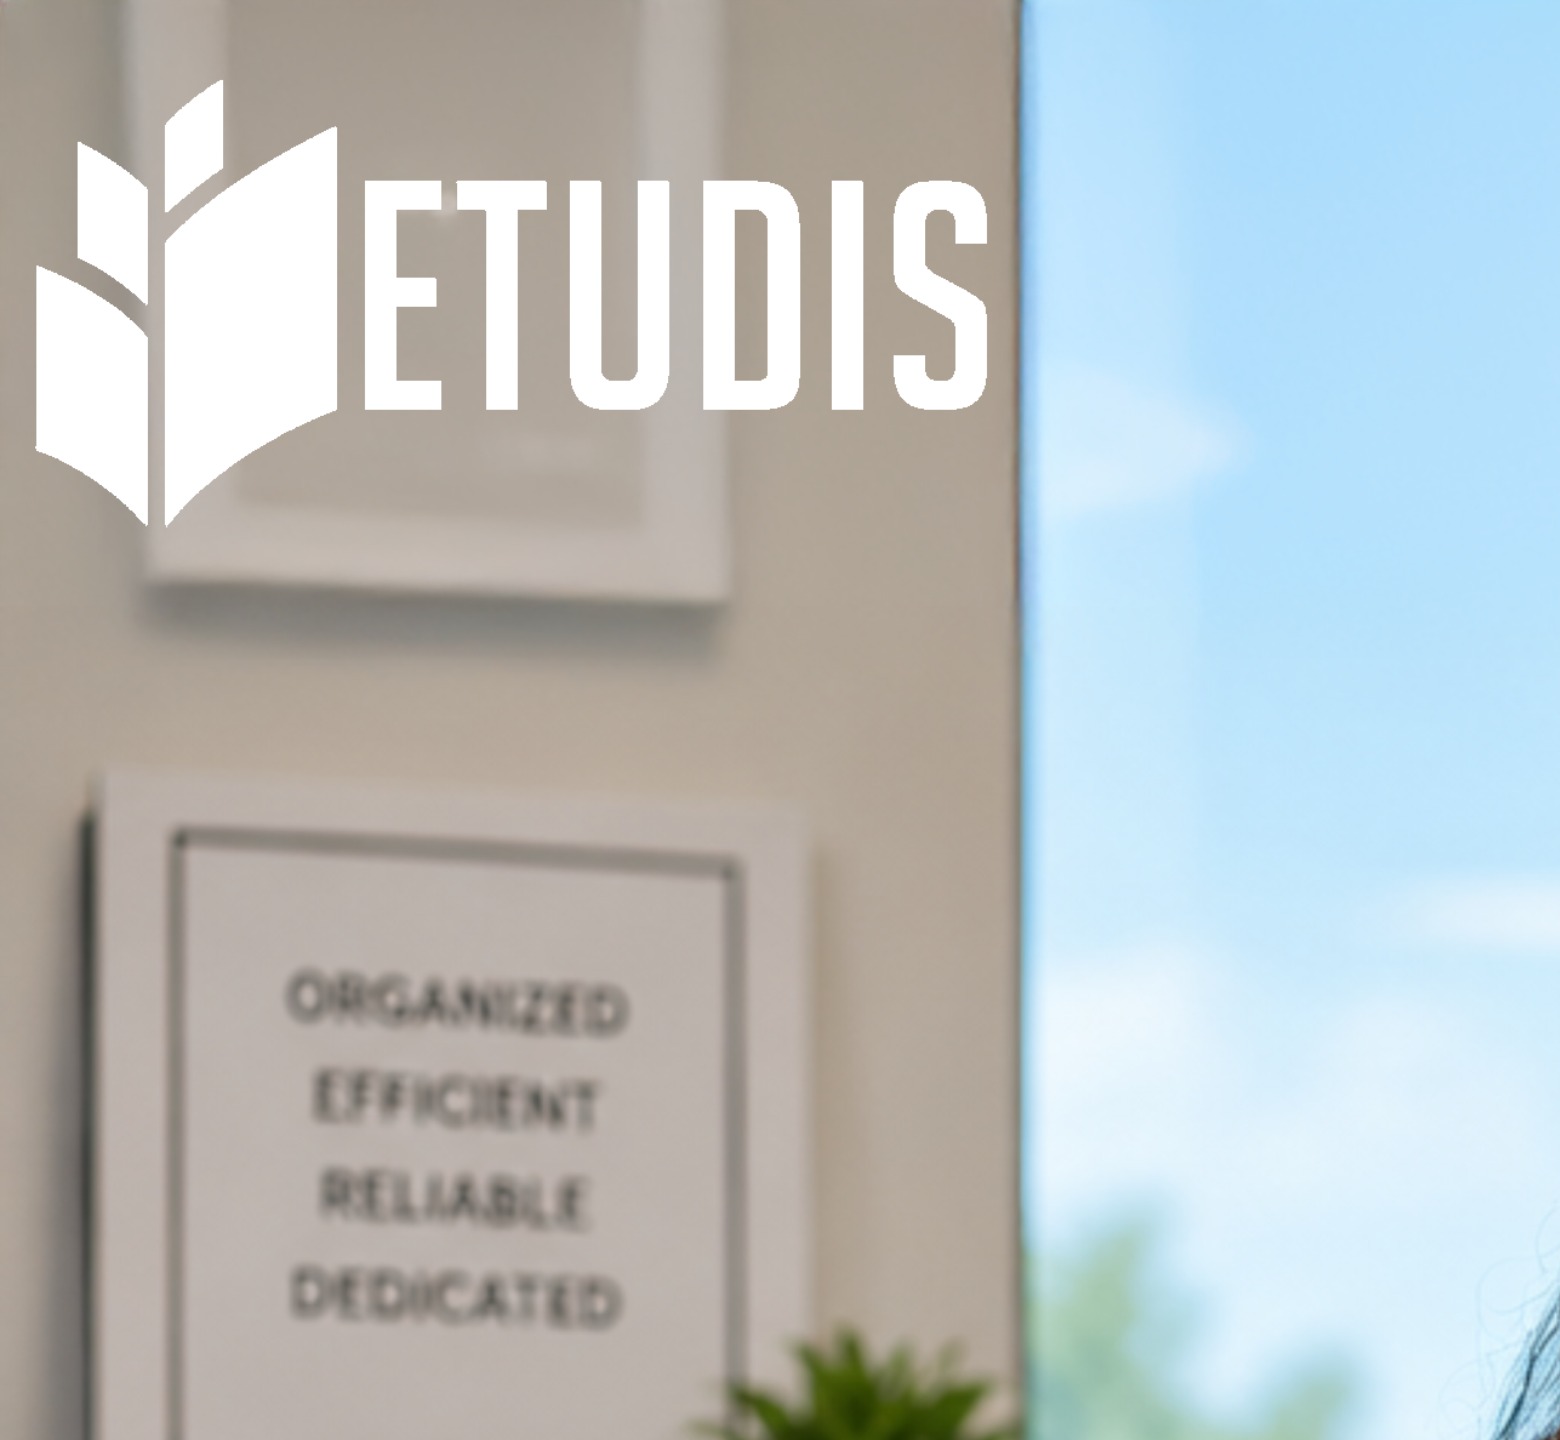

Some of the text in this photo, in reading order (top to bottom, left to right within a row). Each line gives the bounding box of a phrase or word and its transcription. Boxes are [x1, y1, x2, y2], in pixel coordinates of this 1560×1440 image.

[285, 969, 630, 1038] ORGANIZED
[312, 1067, 601, 1131] EFFICIENT
[319, 1167, 590, 1231] RELIABLE
[290, 1265, 623, 1331] DEDICATED
